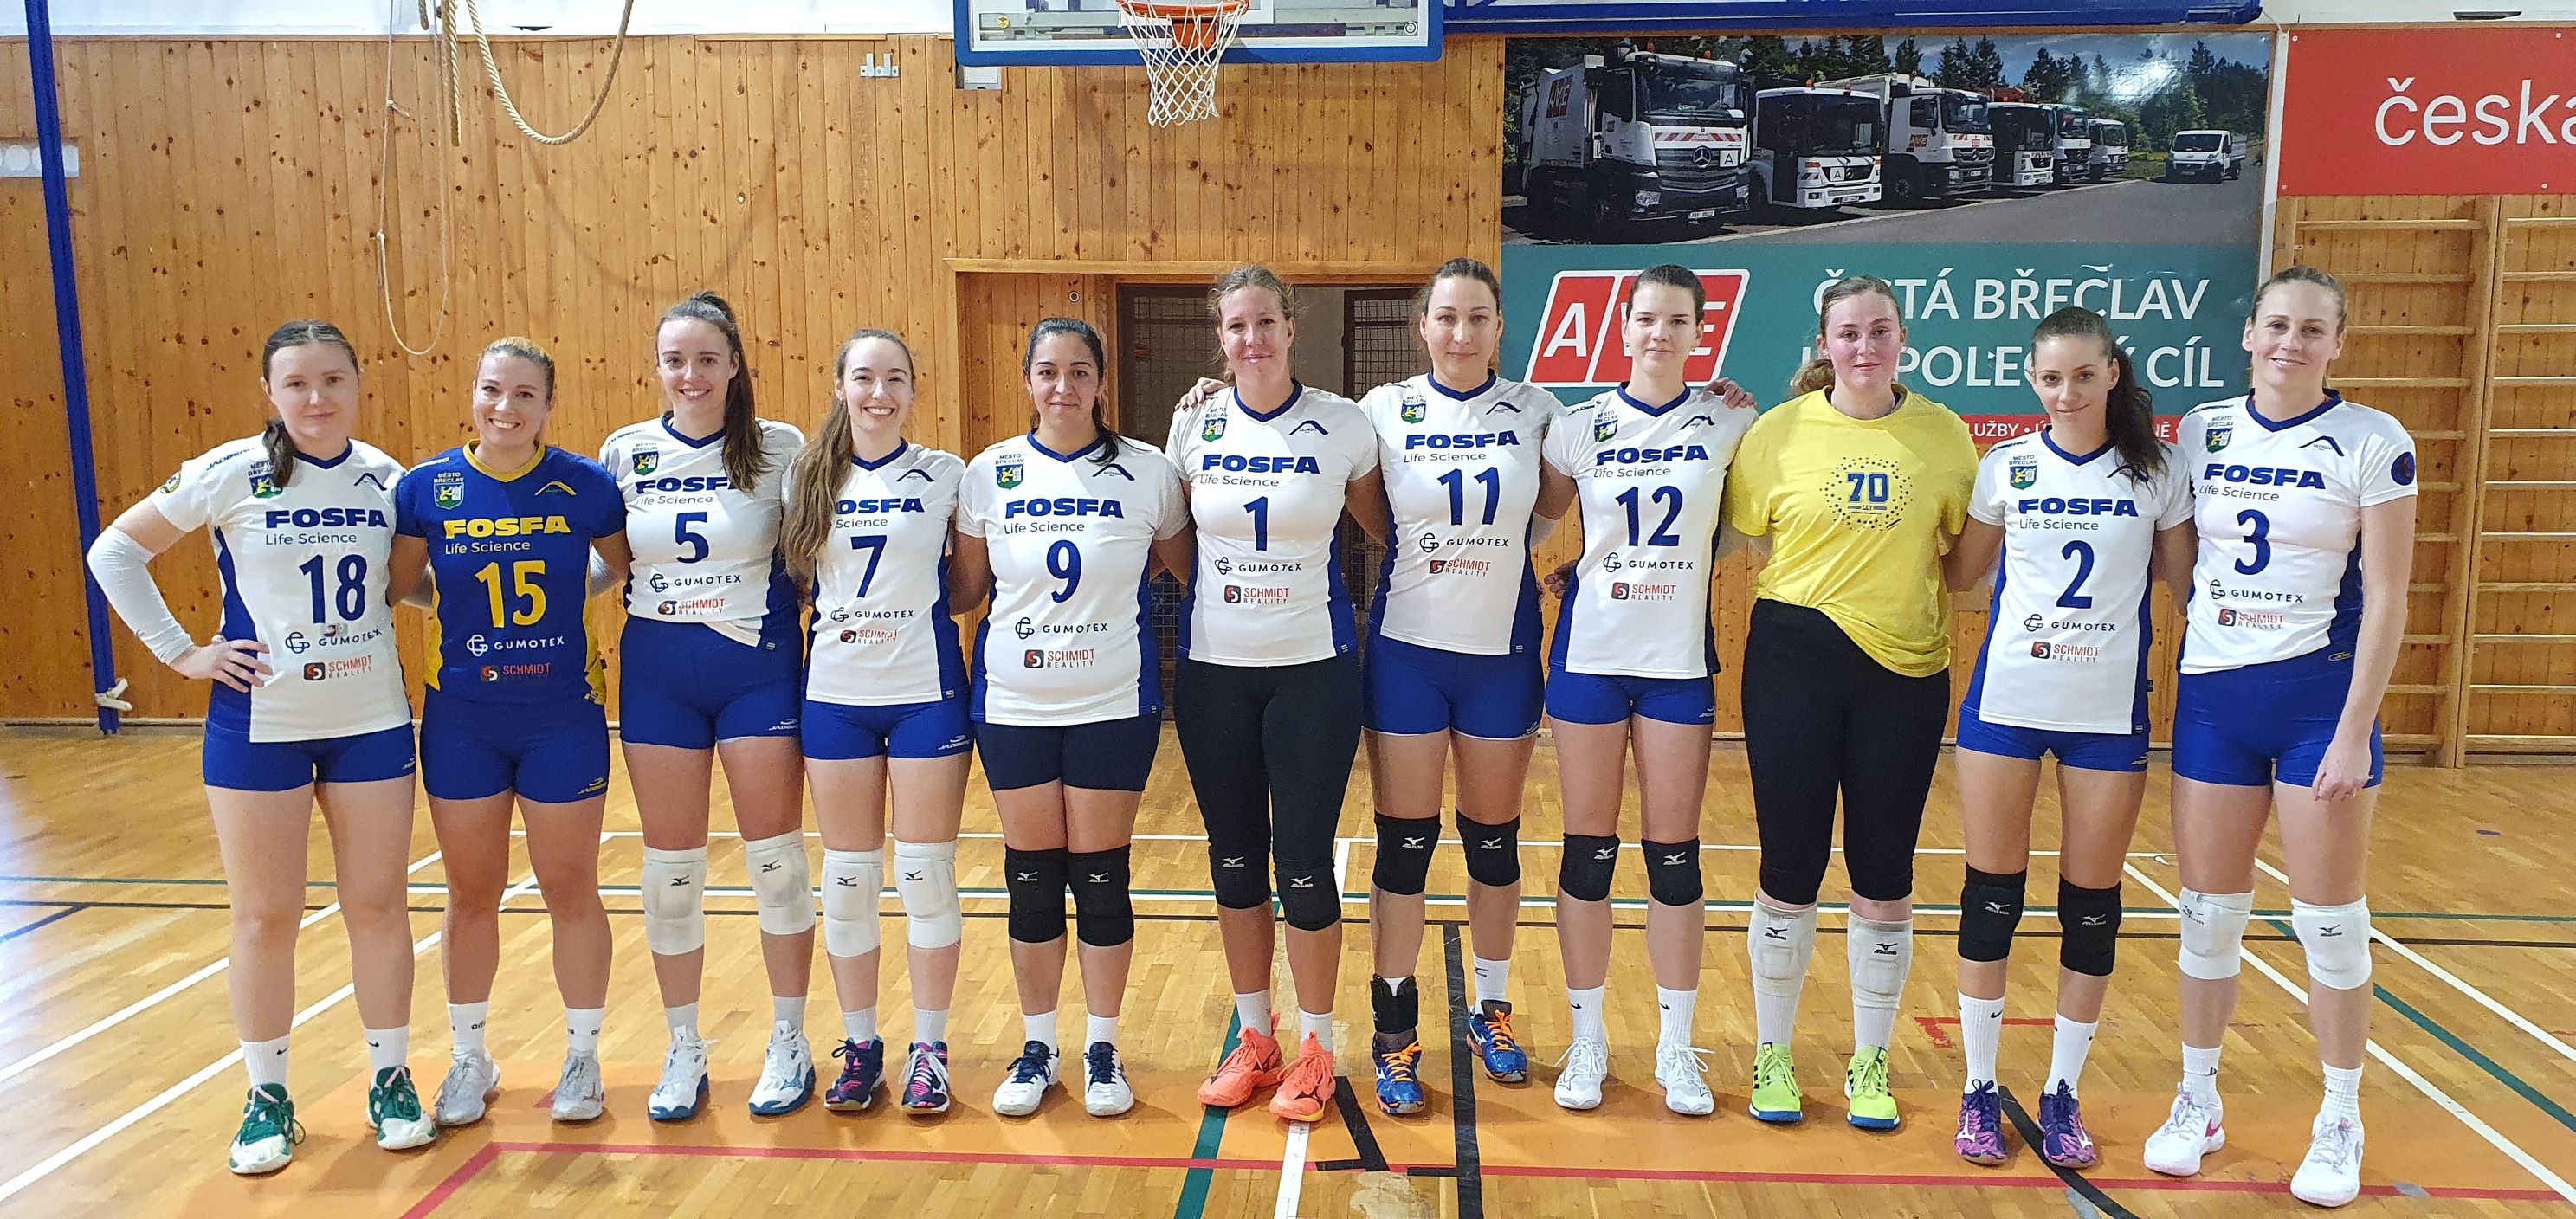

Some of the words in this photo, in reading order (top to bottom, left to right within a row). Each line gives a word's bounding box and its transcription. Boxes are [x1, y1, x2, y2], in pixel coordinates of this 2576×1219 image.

[1723, 153, 1733, 165] A
[1973, 268, 2210, 319] BŘECLAV
[1543, 301, 1726, 358] AE
[2147, 336, 2224, 388] CÍL
[1405, 430, 1520, 450] FOSFA
[1404, 453, 1426, 463] Life
[1430, 453, 1487, 461] Science
[1596, 445, 1708, 466] FOSFA
[1203, 454, 1320, 474] FOSFA
[1593, 468, 1613, 478] Life
[1617, 468, 1671, 477] Science
[2203, 463, 2326, 490] FOSFA
[1199, 474, 1219, 485] Life
[1222, 475, 1280, 487] Science
[1846, 473, 1888, 502] 70
[657, 496, 713, 505] Science
[1436, 467, 1501, 526] 11
[2198, 485, 2219, 496] Life
[2223, 486, 2280, 502] Science
[835, 498, 926, 514] OSFA
[1004, 498, 1125, 519] FOSFA
[2018, 497, 2139, 517] FOSFA
[265, 508, 389, 528] FOSFA
[1615, 485, 1683, 547] 12
[443, 515, 571, 539] FOSFA
[835, 519, 888, 529] Science
[1004, 524, 1027, 534] Life
[1030, 522, 1086, 532] Science
[1243, 496, 1269, 551] 1
[2019, 519, 2040, 530] Life
[2043, 519, 2099, 531] Science
[266, 533, 294, 545] Life
[298, 532, 357, 545] Science
[675, 512, 710, 564] 5
[1446, 537, 1509, 547] GUMOTEX
[2234, 508, 2271, 576] 3
[445, 542, 468, 555] Life
[470, 541, 531, 553] Science
[850, 534, 888, 598] 7
[1046, 539, 1082, 603] 9
[1238, 563, 1302, 572] GUMOTEX
[1446, 558, 1491, 571] SCHMIDT
[1628, 559, 1694, 570] GUMOTEX
[1445, 568, 1488, 577] REALITY
[2056, 540, 2095, 609] 2
[674, 574, 742, 587] GUMOTEX
[299, 554, 367, 624] 18
[475, 560, 546, 628] 15
[1243, 588, 1289, 598] SCHMIDT
[1632, 584, 1677, 595] SCHMIDT
[2231, 589, 2304, 603] GUMOTEX
[678, 598, 726, 610] SCHMIDT
[855, 610, 914, 619] GUMOTEX
[1042, 622, 1108, 634] GUMOTEX
[2050, 621, 2116, 632] GUMOTEX
[318, 629, 383, 647] GUMOTEX
[494, 635, 565, 650] GUMOTEX
[1047, 648, 1095, 661] SCHMIDT
[2053, 644, 2100, 657] SCHMIDT
[328, 655, 372, 673] SCHMIDT
[1046, 660, 1094, 668] REALITY
[2052, 654, 2097, 663] REALITY
[502, 662, 550, 675] SCHMIDT
